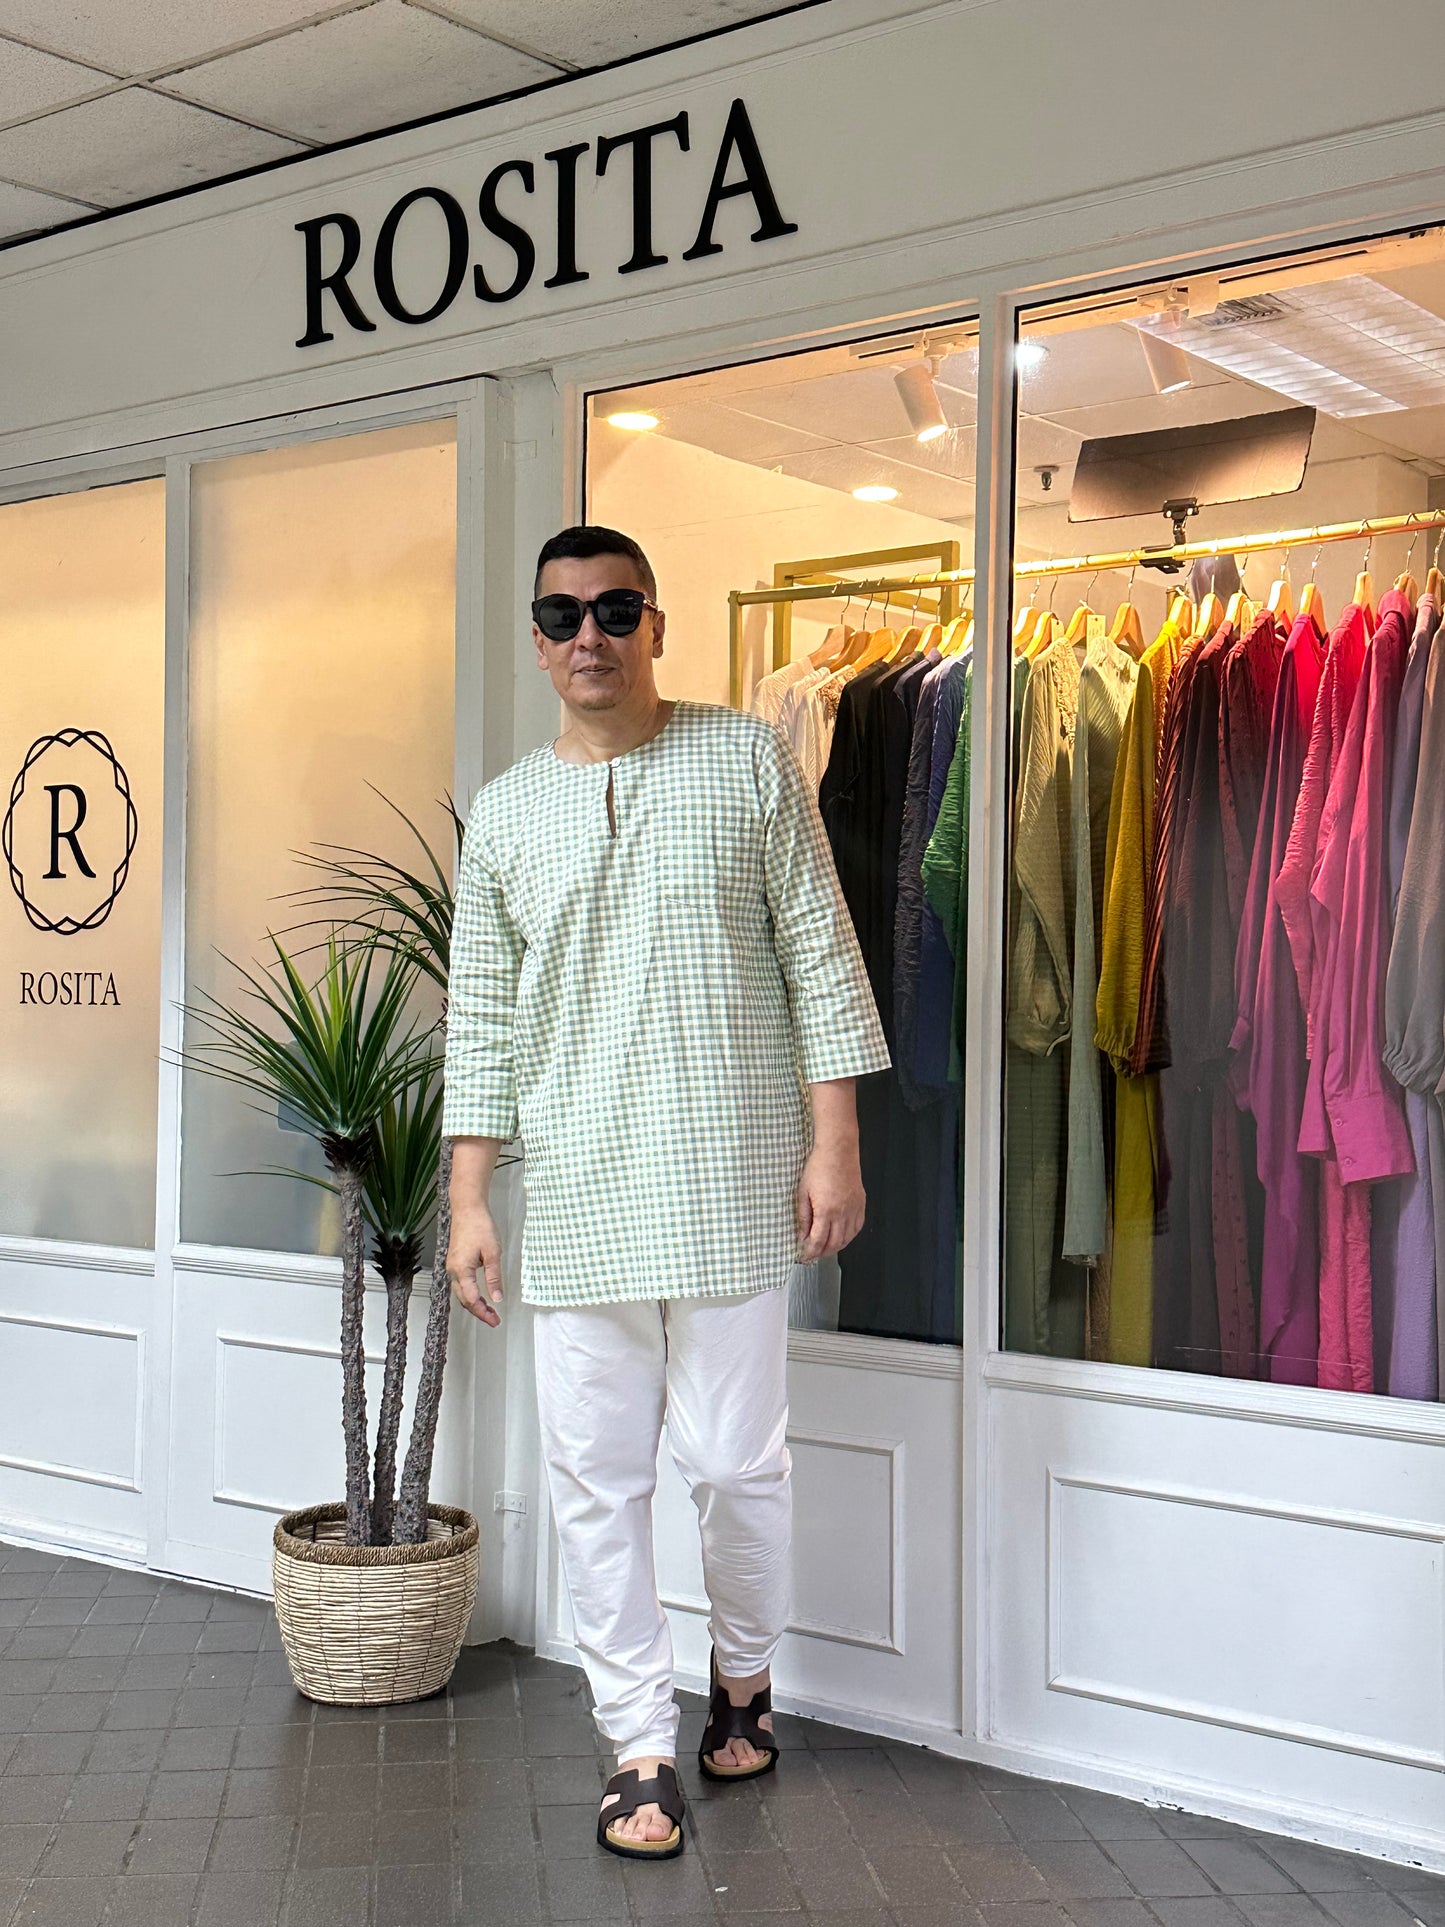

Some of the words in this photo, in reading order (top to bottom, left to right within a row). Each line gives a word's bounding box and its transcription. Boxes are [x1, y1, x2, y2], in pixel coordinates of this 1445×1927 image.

[294, 98, 799, 348] ROSITA
[42, 784, 97, 880] R
[19, 971, 121, 1006] ROSITA
